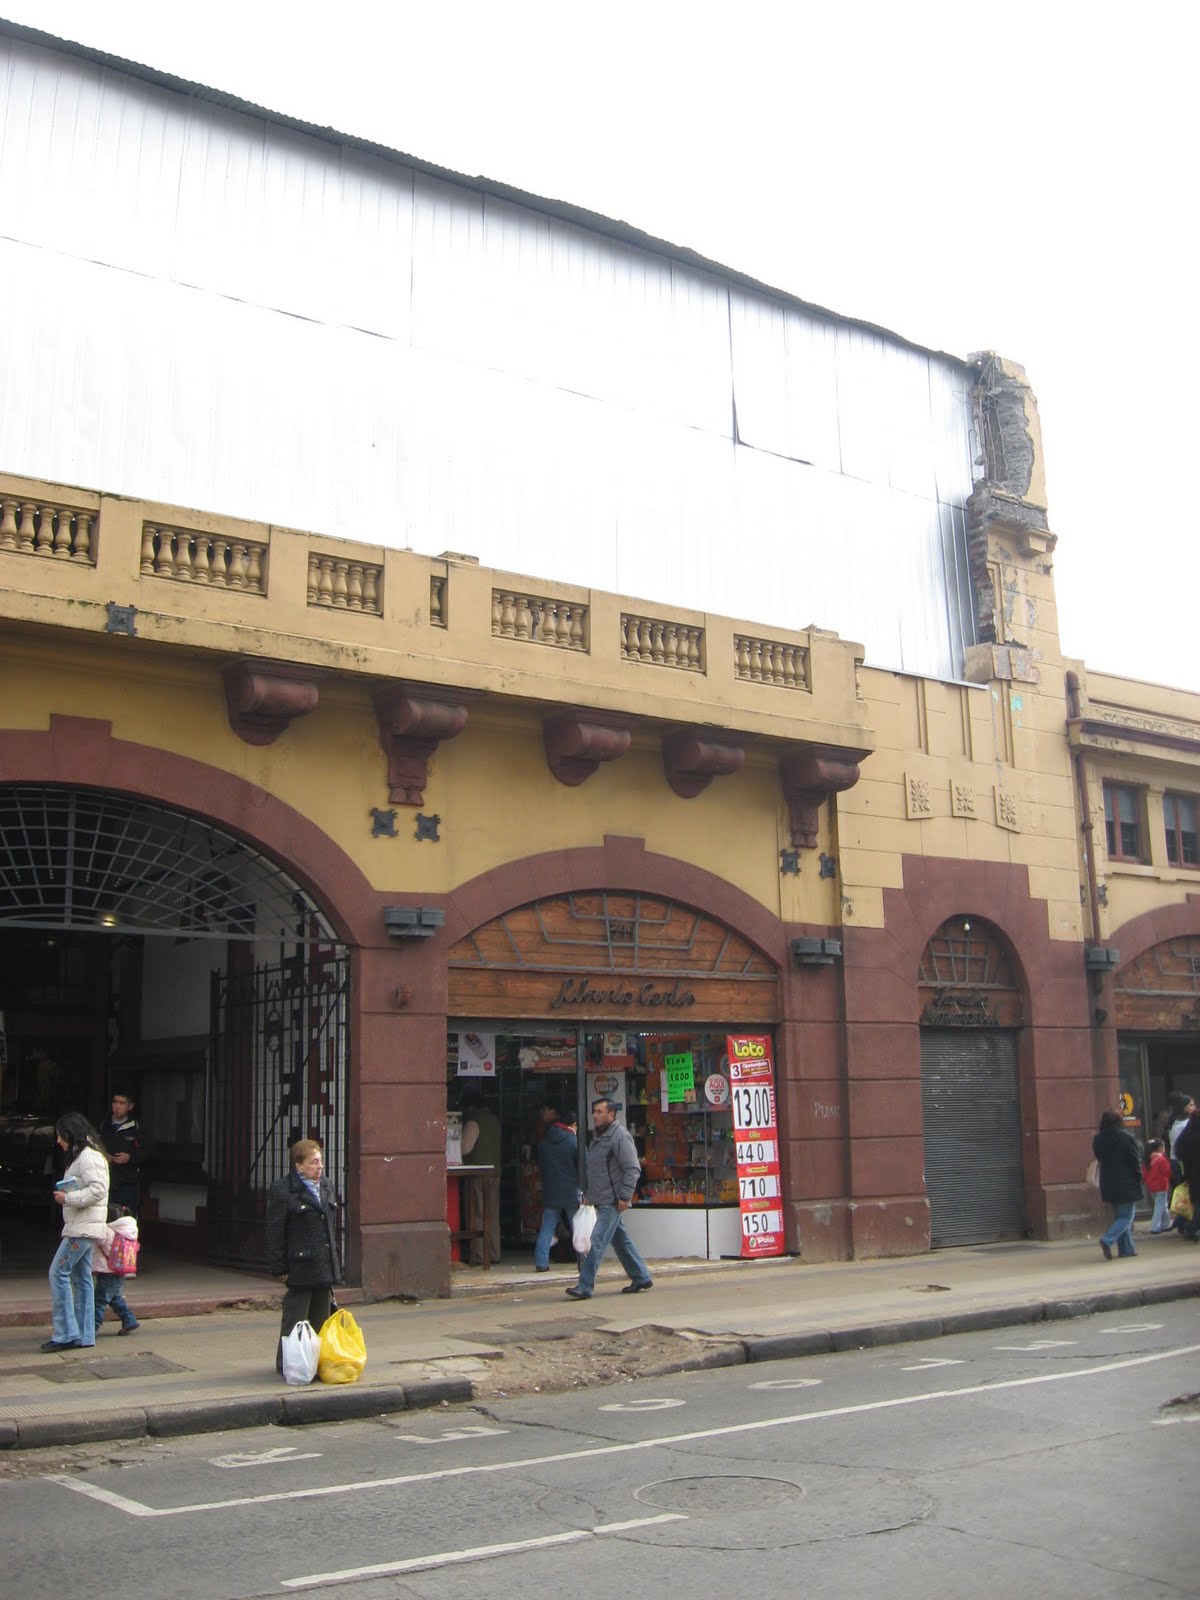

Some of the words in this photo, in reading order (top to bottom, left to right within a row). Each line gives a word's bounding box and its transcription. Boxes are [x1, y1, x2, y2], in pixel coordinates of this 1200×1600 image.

[733, 1040, 765, 1058] Loto
[669, 1072, 690, 1082] 1000
[732, 1064, 741, 1078] 3
[734, 1088, 770, 1127] 1300
[738, 1143, 764, 1162] 440
[740, 1178, 766, 1199] 710
[743, 1213, 769, 1234] 150
